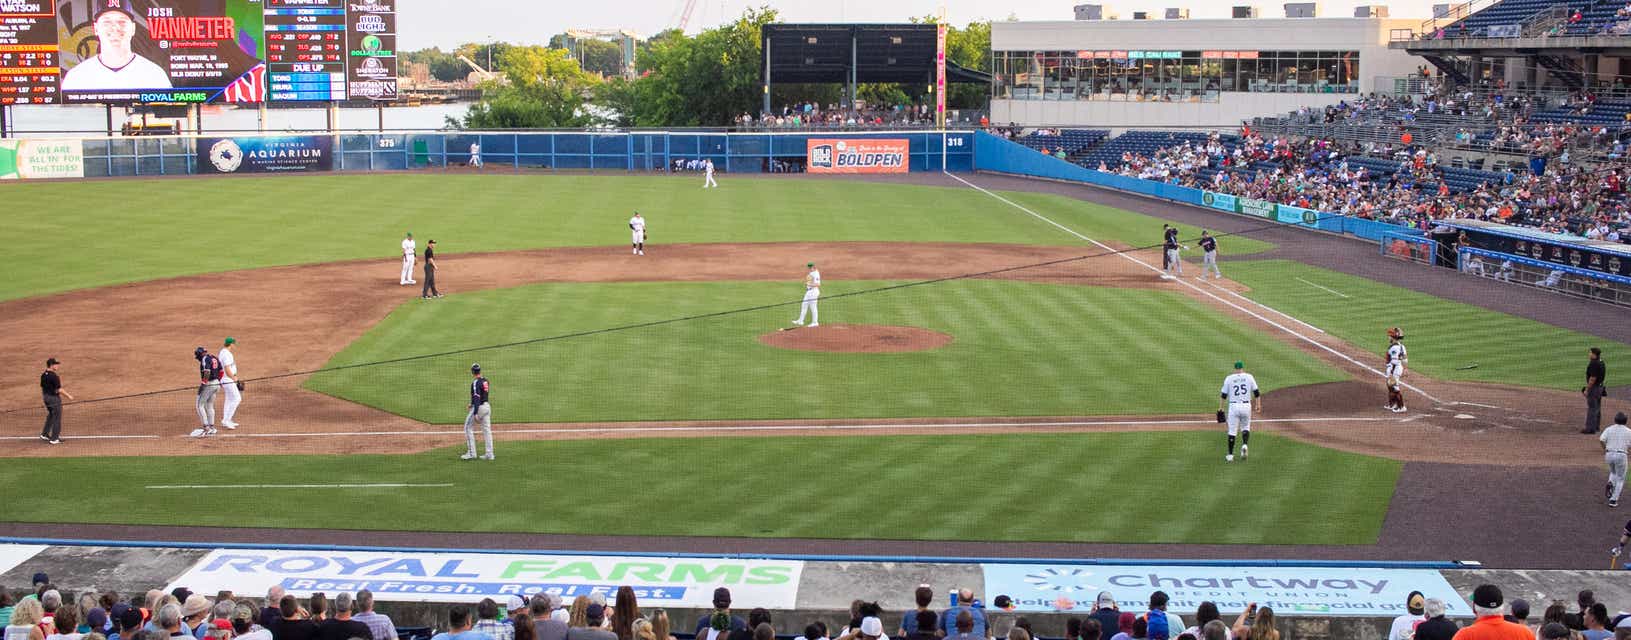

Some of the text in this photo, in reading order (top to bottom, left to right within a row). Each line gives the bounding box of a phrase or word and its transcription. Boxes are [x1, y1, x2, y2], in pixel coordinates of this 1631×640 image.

[1, 4, 40, 12] WATSON
[148, 8, 172, 16] JOSH
[146, 16, 235, 40] VANMETER
[356, 23, 385, 31] LIGHT
[380, 139, 394, 148] 375
[948, 138, 963, 146] 318
[64, 154, 80, 162] FOR
[249, 150, 320, 158] AQUARIUM
[836, 153, 902, 166] BOLDPEN
[1233, 384, 1248, 396] 25
[200, 554, 793, 585] ROYAL FARMS
[292, 580, 370, 590] Real
[379, 581, 482, 594] Fresh.
[499, 584, 576, 596] Real
[1108, 574, 1389, 594] Chartway
